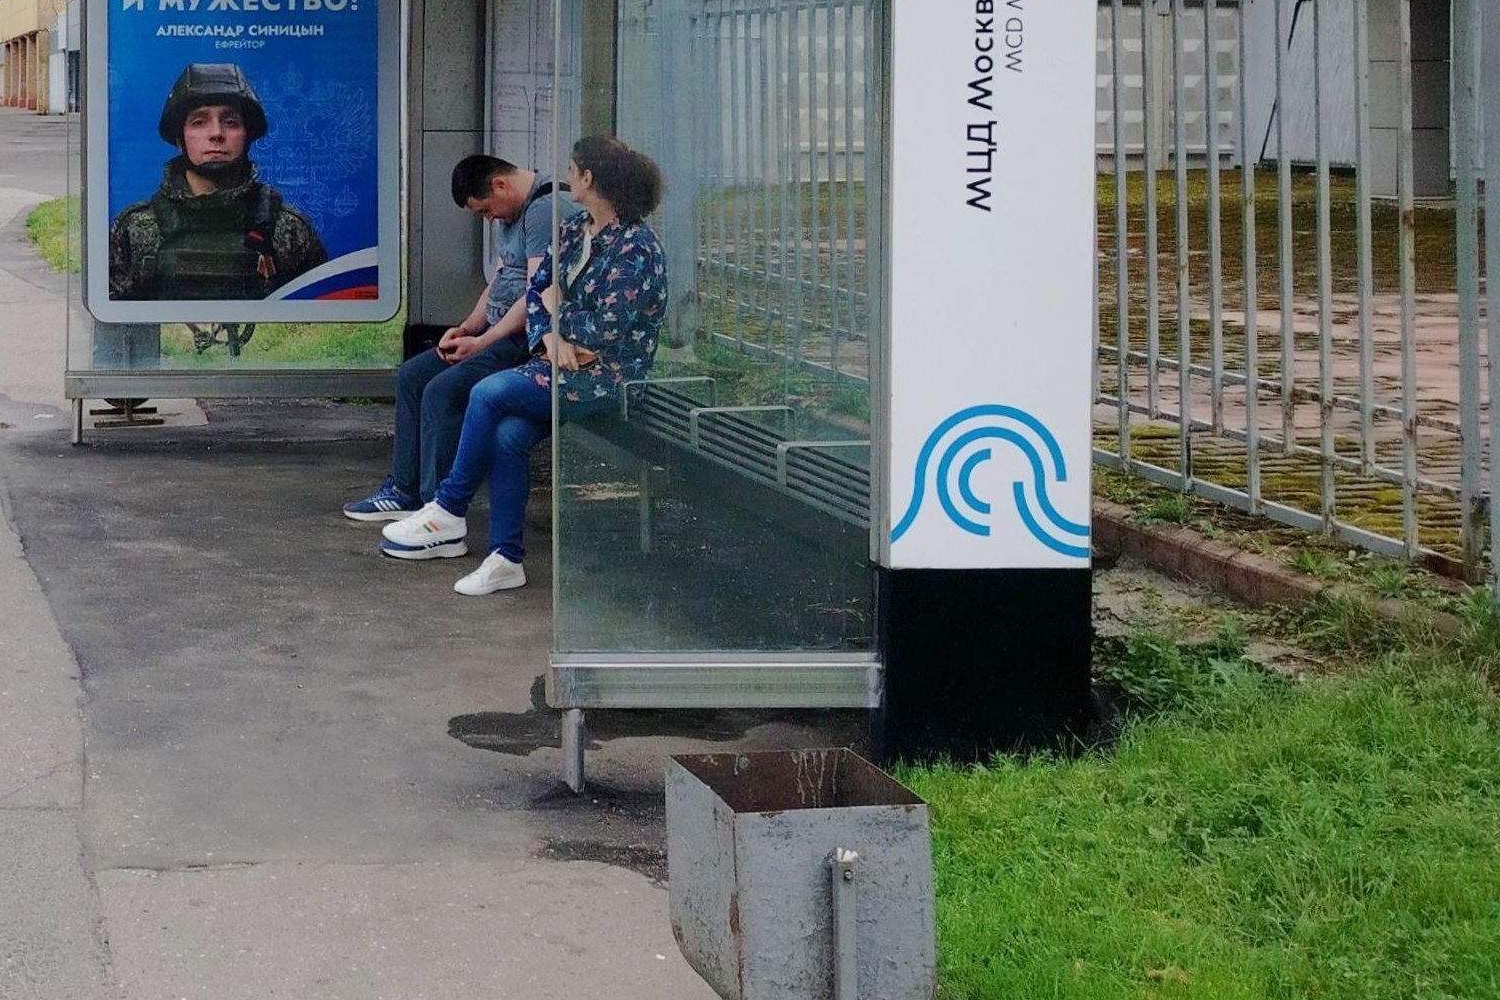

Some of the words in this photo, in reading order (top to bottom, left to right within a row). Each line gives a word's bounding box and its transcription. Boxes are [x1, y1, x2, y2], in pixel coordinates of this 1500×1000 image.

[156, 25, 244, 37] АЛЕКСАНДР
[248, 25, 324, 38] СИНИЦЫН
[215, 40, 265, 49] ЕФРЕЙТОР
[1006, 17, 1023, 72] MCD
[966, 120, 997, 211] МЦД
